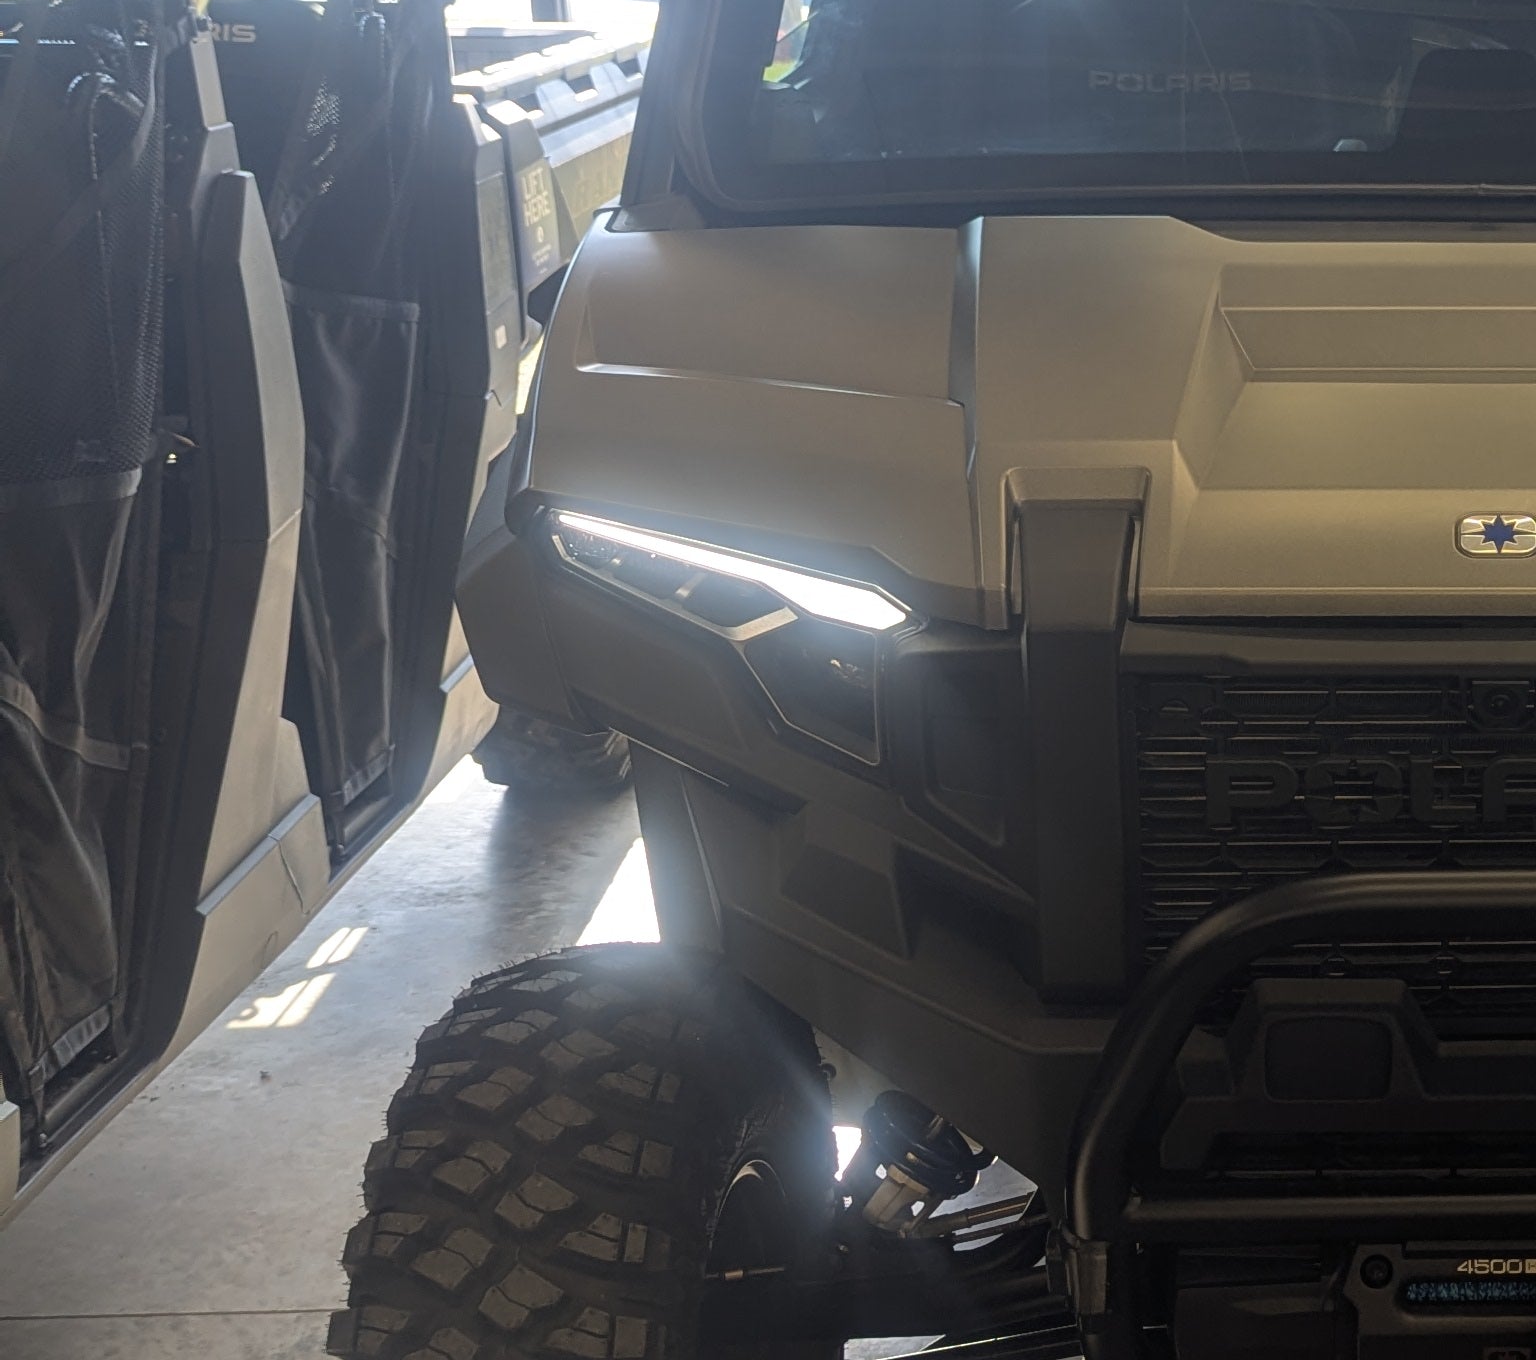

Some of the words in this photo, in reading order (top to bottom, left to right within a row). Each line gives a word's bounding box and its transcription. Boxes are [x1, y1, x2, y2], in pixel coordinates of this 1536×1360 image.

[1087, 70, 1252, 92] POLARIS
[522, 167, 545, 200] LIFT
[524, 191, 551, 227] HERE
[1456, 1258, 1522, 1275] 4500
